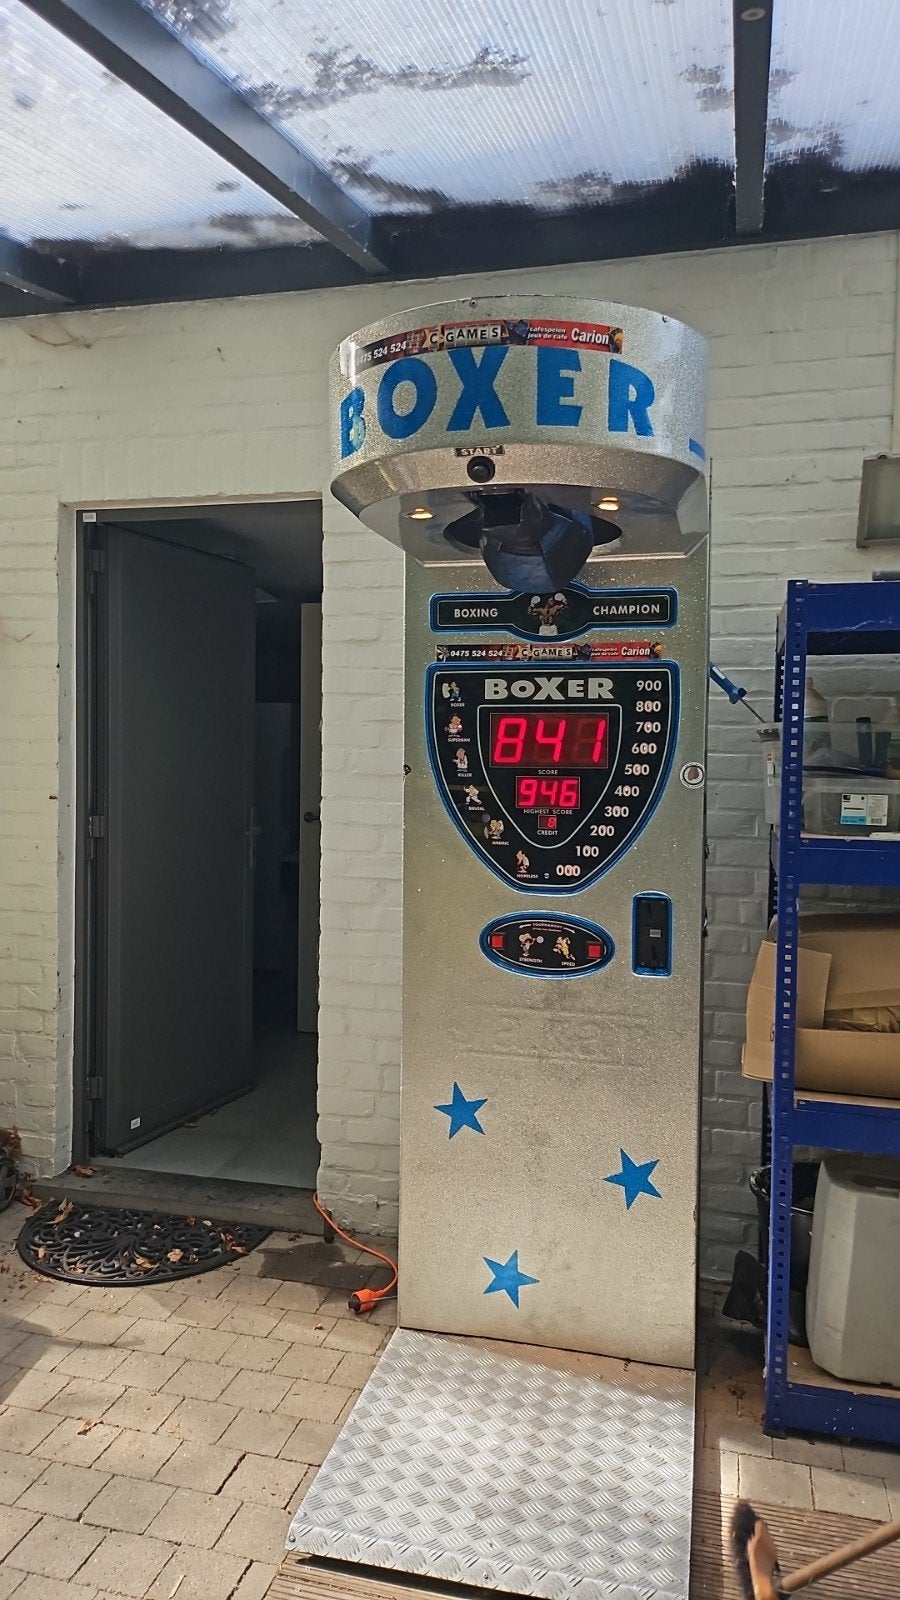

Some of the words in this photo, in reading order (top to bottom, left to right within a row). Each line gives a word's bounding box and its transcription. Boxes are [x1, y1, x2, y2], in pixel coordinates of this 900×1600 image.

[571, 327, 610, 345] Carion
[373, 345, 388, 359] 524
[390, 340, 407, 354] 524
[446, 327, 499, 343] GAMES
[340, 345, 656, 460] BOXER
[460, 447, 498, 456] START
[454, 608, 499, 618] BOXING
[593, 604, 660, 616] CHAMPION
[533, 647, 571, 657] GAMES
[621, 646, 651, 656] Carion
[484, 677, 615, 700] BOXER
[636, 680, 662, 691] 900
[635, 700, 662, 713] 800
[635, 721, 661, 733] 700
[493, 717, 606, 763] 841
[631, 742, 657, 755] 600
[624, 763, 650, 776] 500
[519, 779, 578, 807] 946
[614, 785, 640, 797] 400
[604, 806, 629, 818] 300
[590, 825, 615, 837] 200
[575, 845, 600, 857] 100
[556, 864, 581, 877] 000
